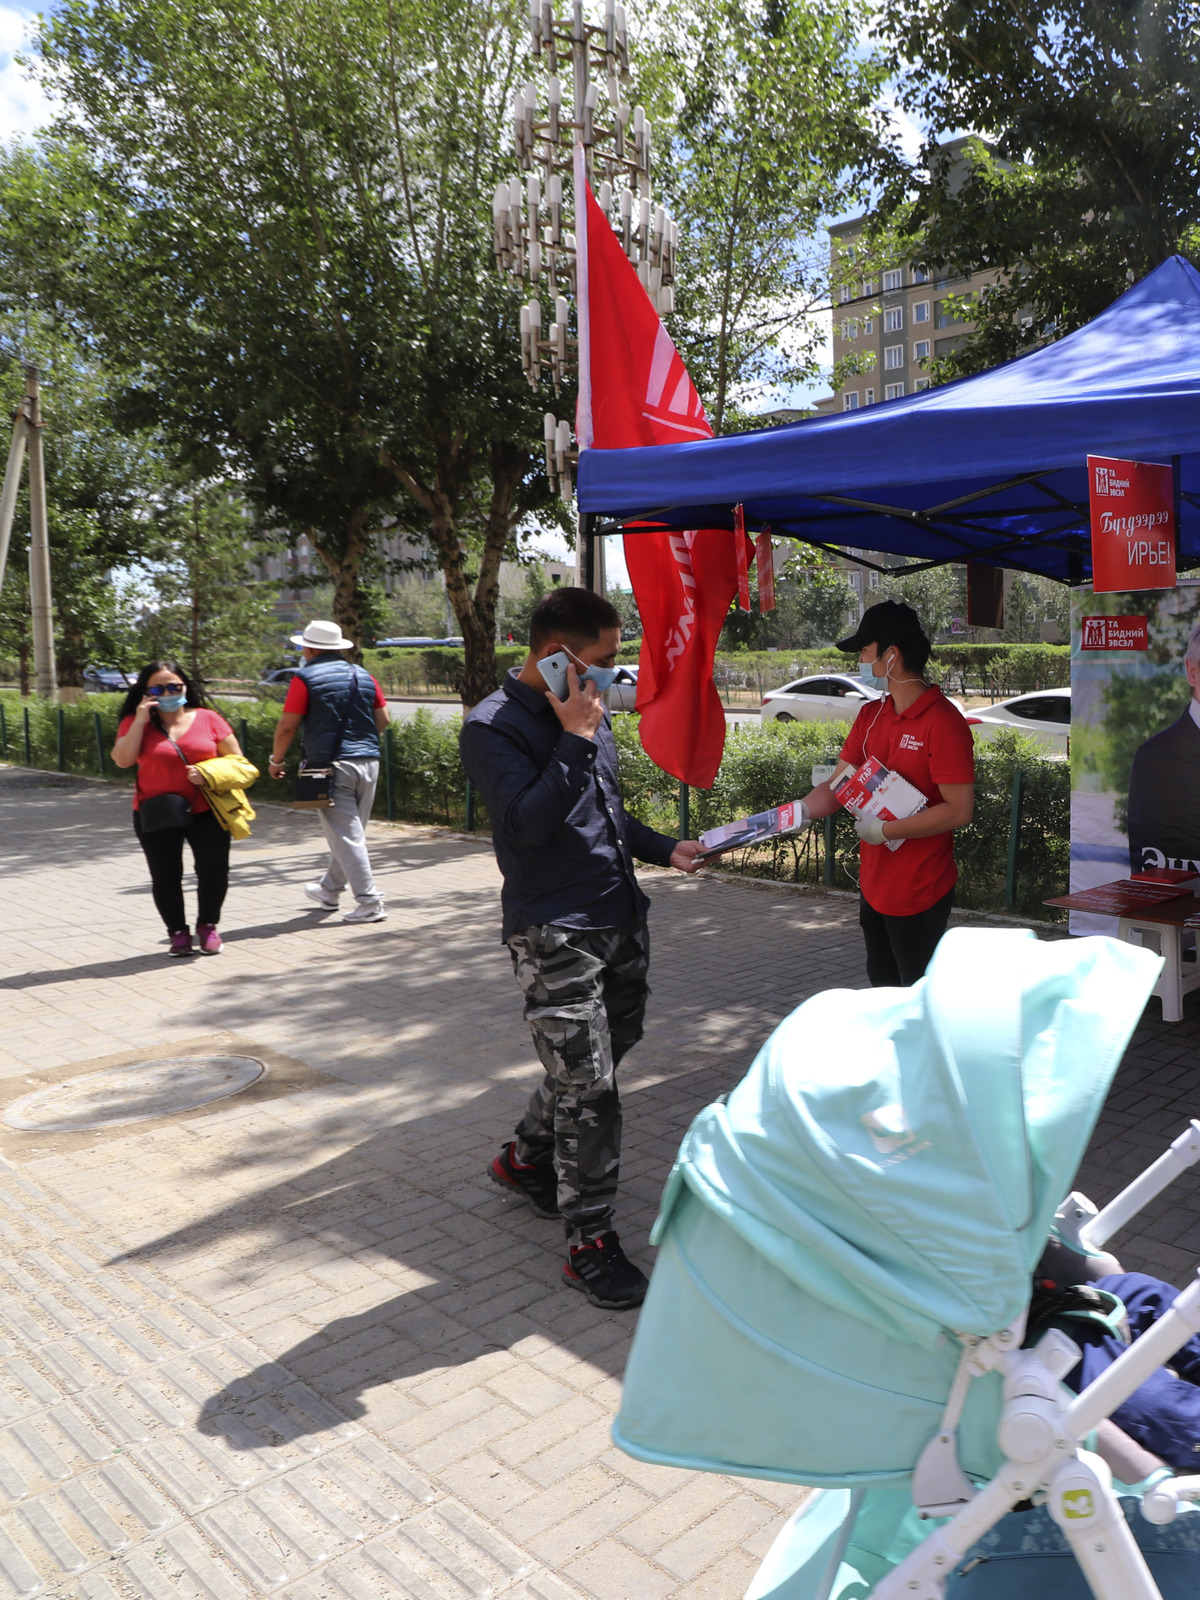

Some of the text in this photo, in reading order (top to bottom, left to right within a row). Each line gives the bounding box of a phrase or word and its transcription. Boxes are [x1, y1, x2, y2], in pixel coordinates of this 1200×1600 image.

[1109, 469, 1116, 477] ТА
[1109, 479, 1130, 488] БИДНИЙ
[1109, 489, 1125, 497] ЭВСЭЛ
[1127, 541, 1171, 565] ИРЬЕ!
[1108, 628, 1144, 639] БИДНИЙ
